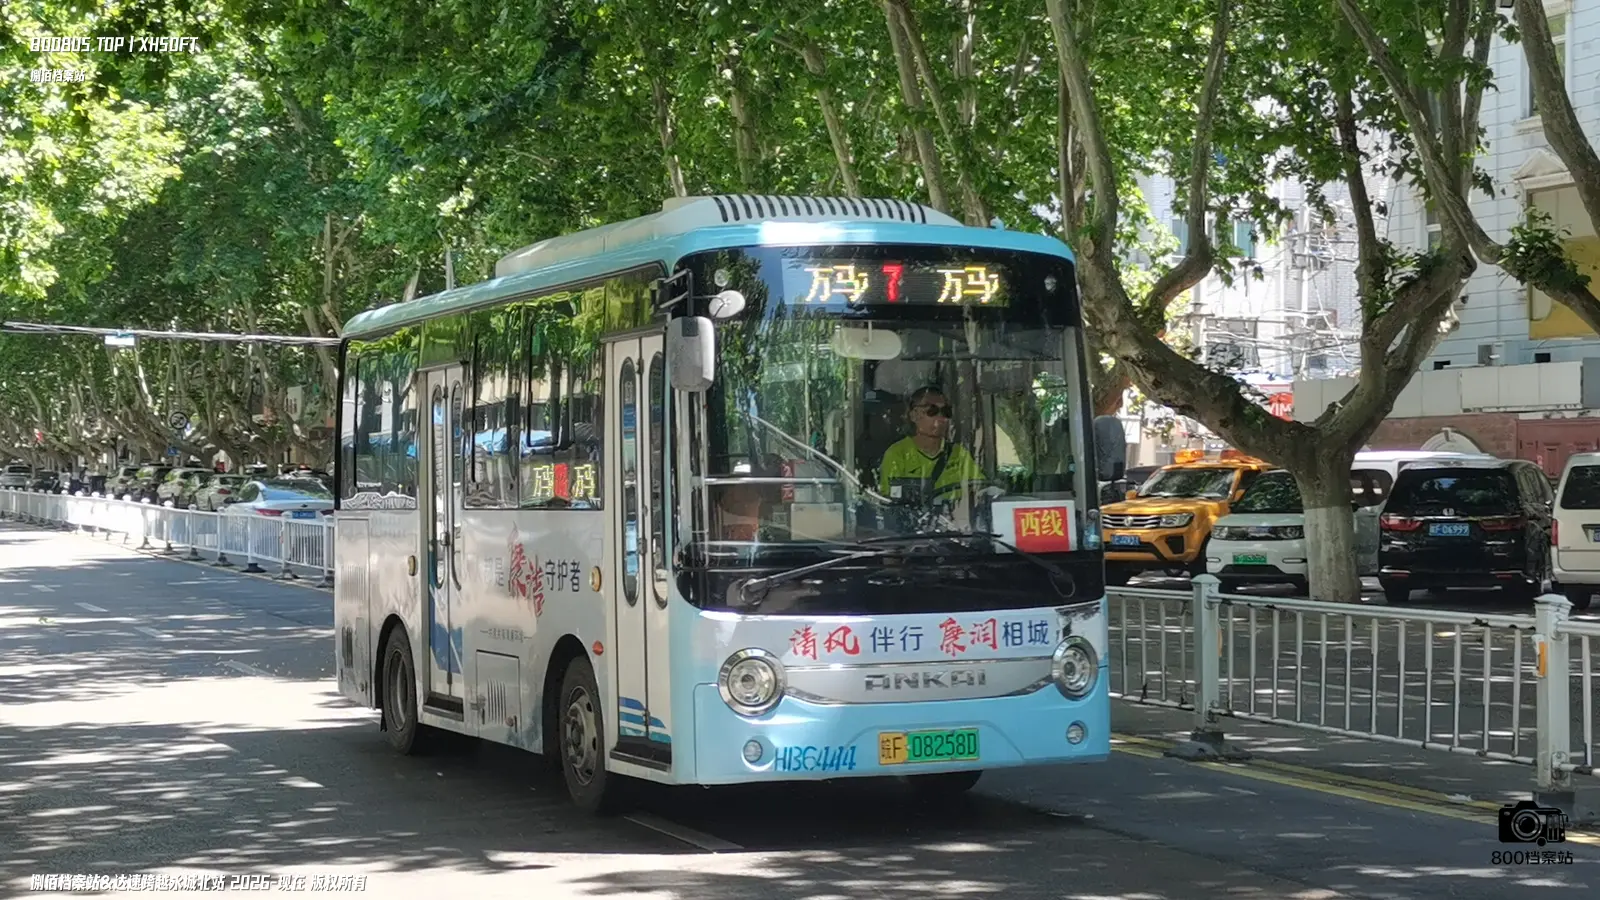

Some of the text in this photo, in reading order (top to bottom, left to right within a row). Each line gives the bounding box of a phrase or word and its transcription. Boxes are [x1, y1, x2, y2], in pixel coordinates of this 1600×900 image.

[882, 261, 904, 303] 7
[1018, 509, 1064, 537] 西线
[864, 669, 987, 691] ANKAI
